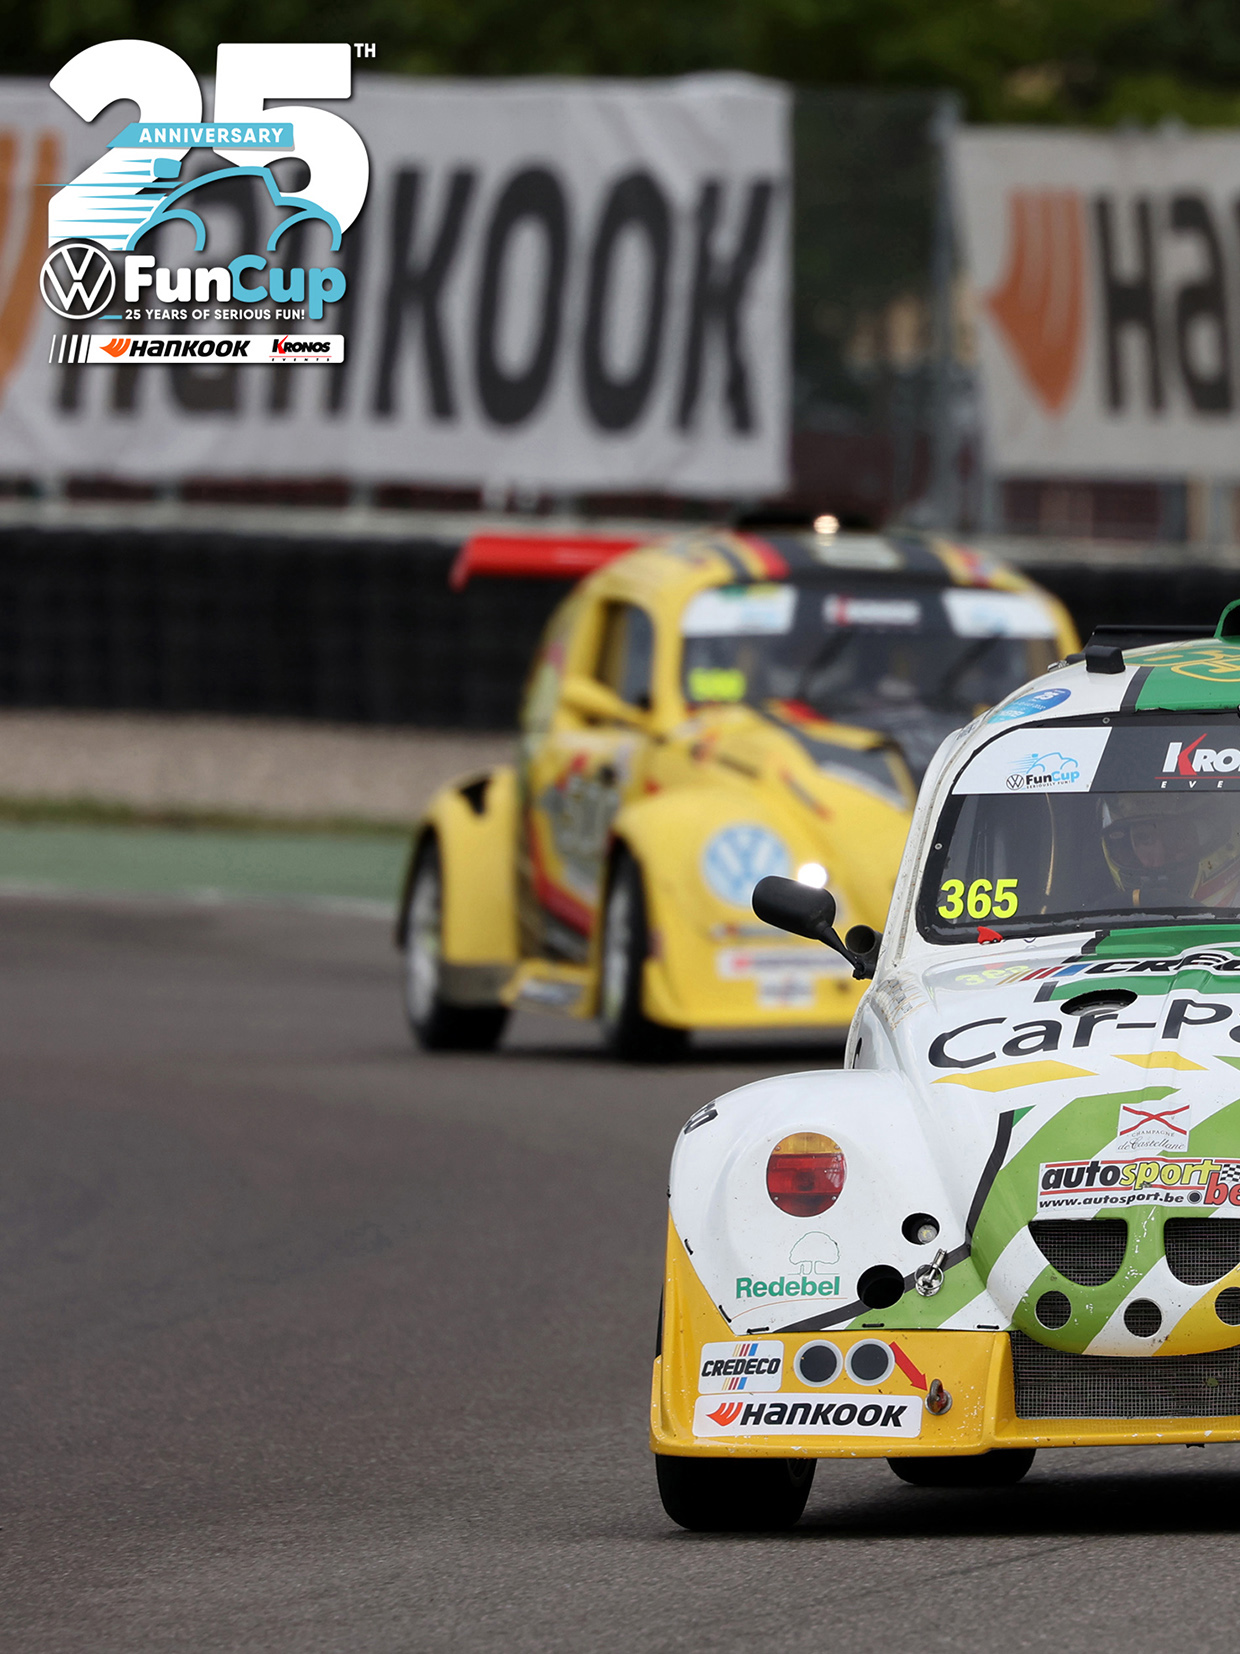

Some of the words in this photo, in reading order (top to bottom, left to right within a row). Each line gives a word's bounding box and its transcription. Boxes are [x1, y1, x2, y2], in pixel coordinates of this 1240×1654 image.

[1026, 770, 1080, 785] FunCup
[938, 879, 1019, 919] 365
[1131, 1130, 1175, 1138] CHAMPAGNE
[1039, 1191, 1184, 1208] www.autosport.be
[736, 1276, 841, 1299] Redebel
[701, 1358, 782, 1377] CREDECO
